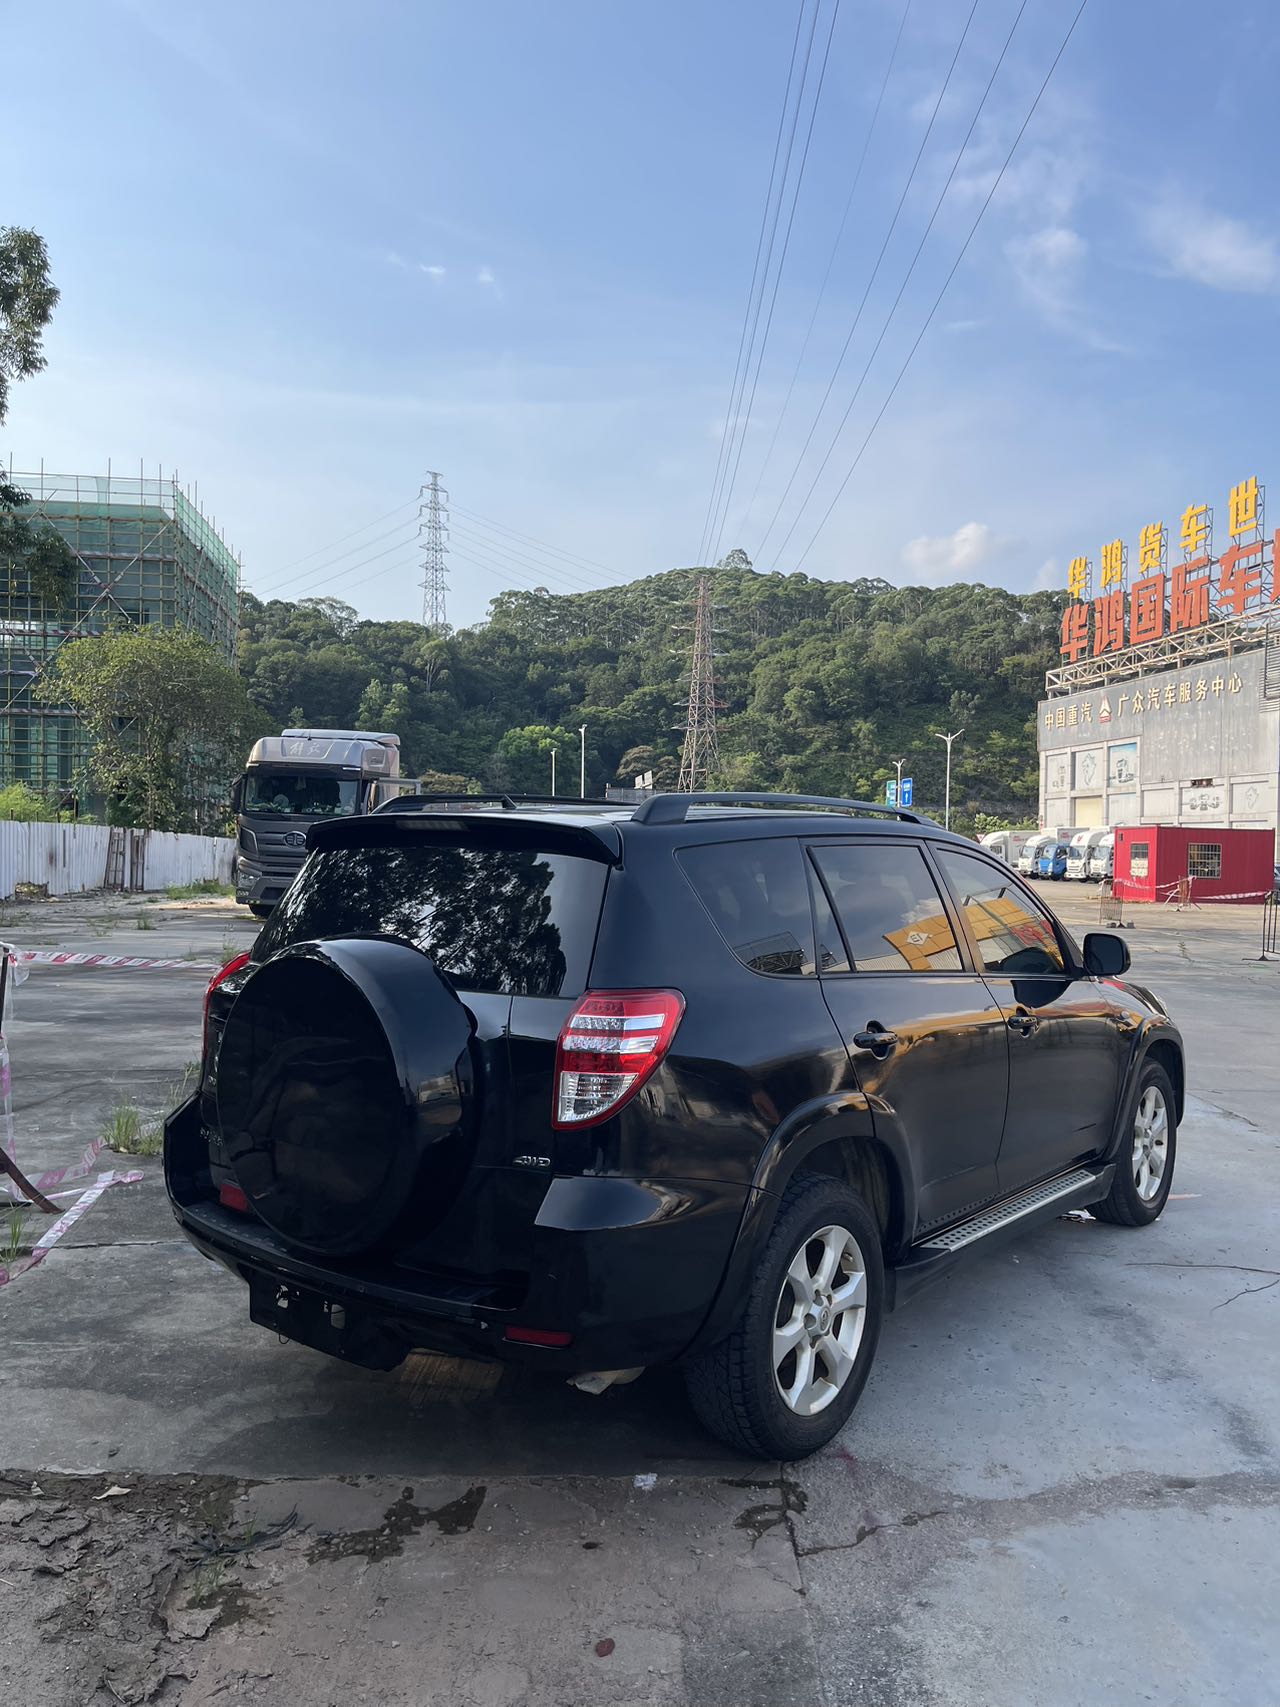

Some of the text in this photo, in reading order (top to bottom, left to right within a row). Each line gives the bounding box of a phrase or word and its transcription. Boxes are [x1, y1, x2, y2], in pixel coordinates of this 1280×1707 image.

[1068, 475, 1258, 598] 华鸿货车世
[1045, 672, 1243, 730] 中国重汽 广众汽车服务中心
